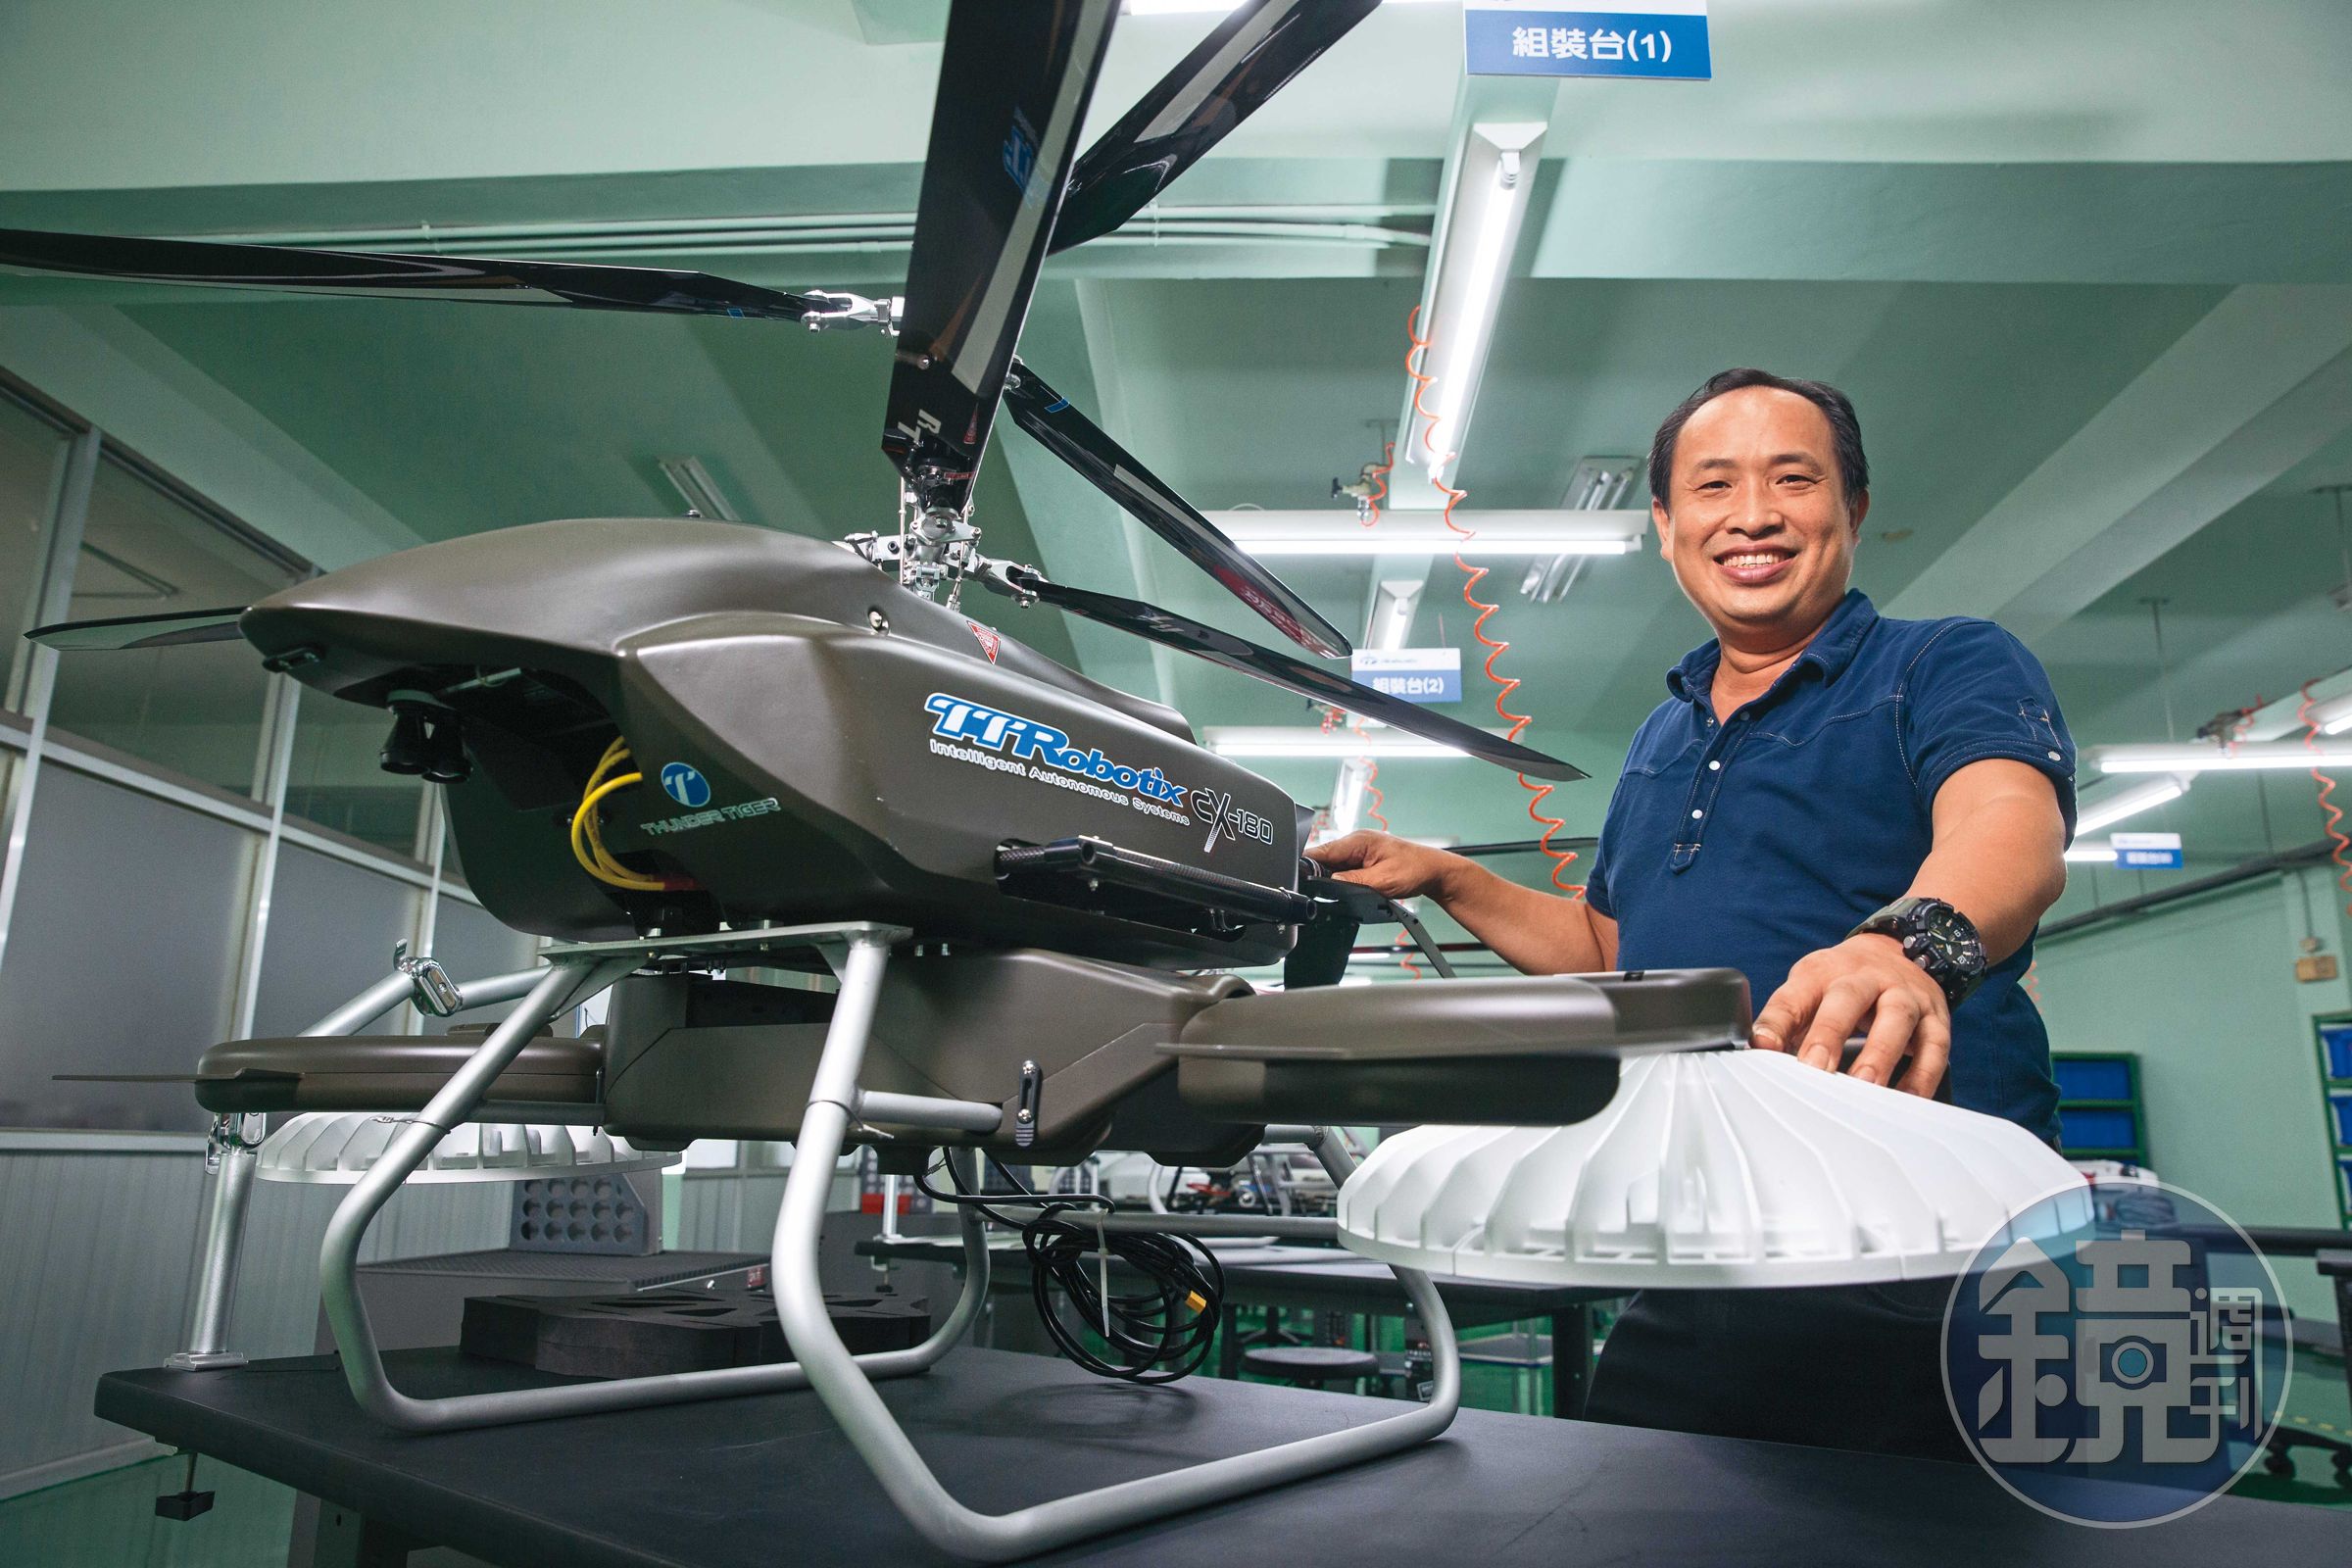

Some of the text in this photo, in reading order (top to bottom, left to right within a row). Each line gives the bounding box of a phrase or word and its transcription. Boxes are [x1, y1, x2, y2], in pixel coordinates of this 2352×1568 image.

[1512, 26, 1672, 62] 組裝台(1)
[929, 739, 1190, 826] Intelligent Autonomous Systems
[640, 798, 781, 835] THUNDER TIGER
[1190, 788, 1274, 853] CX-180
